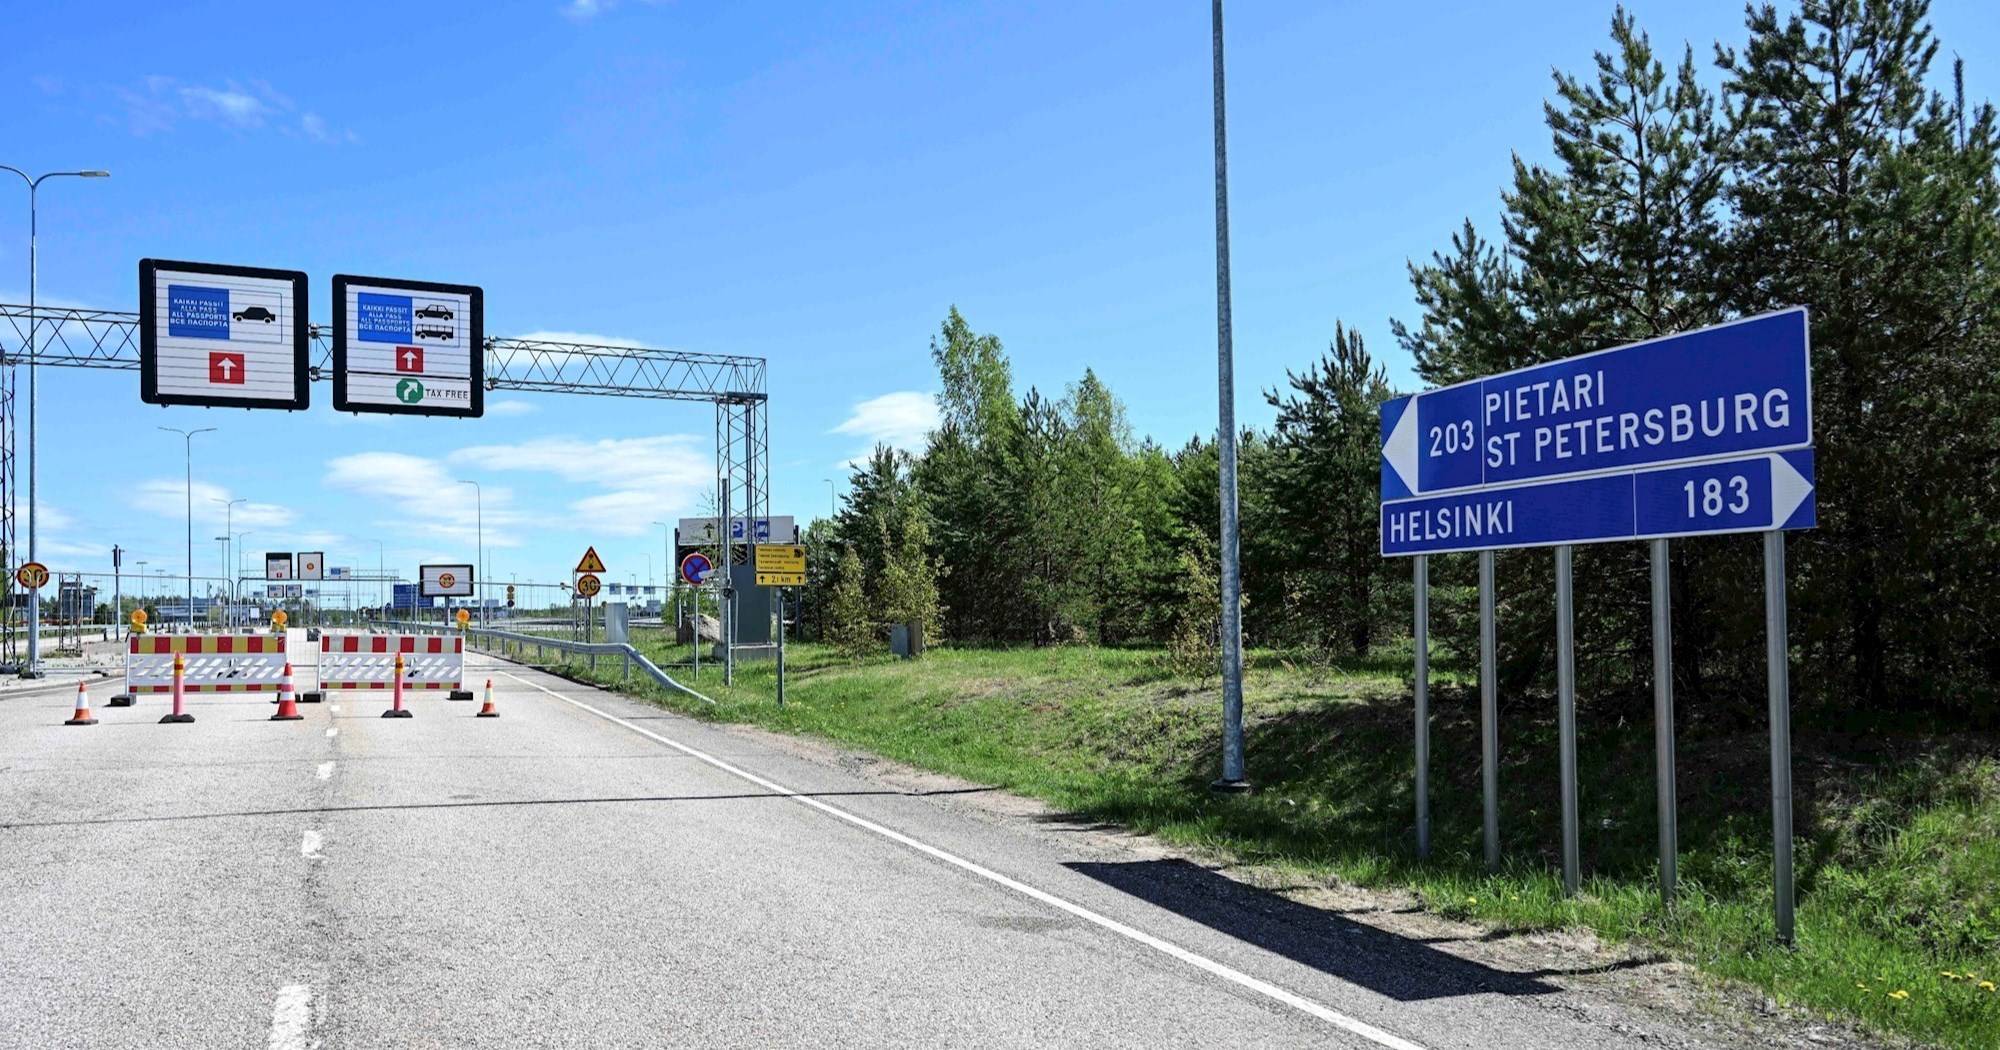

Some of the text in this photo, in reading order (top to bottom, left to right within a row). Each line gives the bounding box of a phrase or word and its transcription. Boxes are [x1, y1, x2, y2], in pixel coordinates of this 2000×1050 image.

[186, 312, 227, 320] PASSPORTS
[426, 388, 468, 399] TAX FREE
[1485, 370, 1604, 426] PIETARI
[1429, 420, 1474, 458] 203
[1486, 388, 1790, 468] ST PETERSBURG
[1684, 475, 1750, 518] 183
[1390, 500, 1513, 543] HELSINKI
[582, 580, 596, 592] 30
